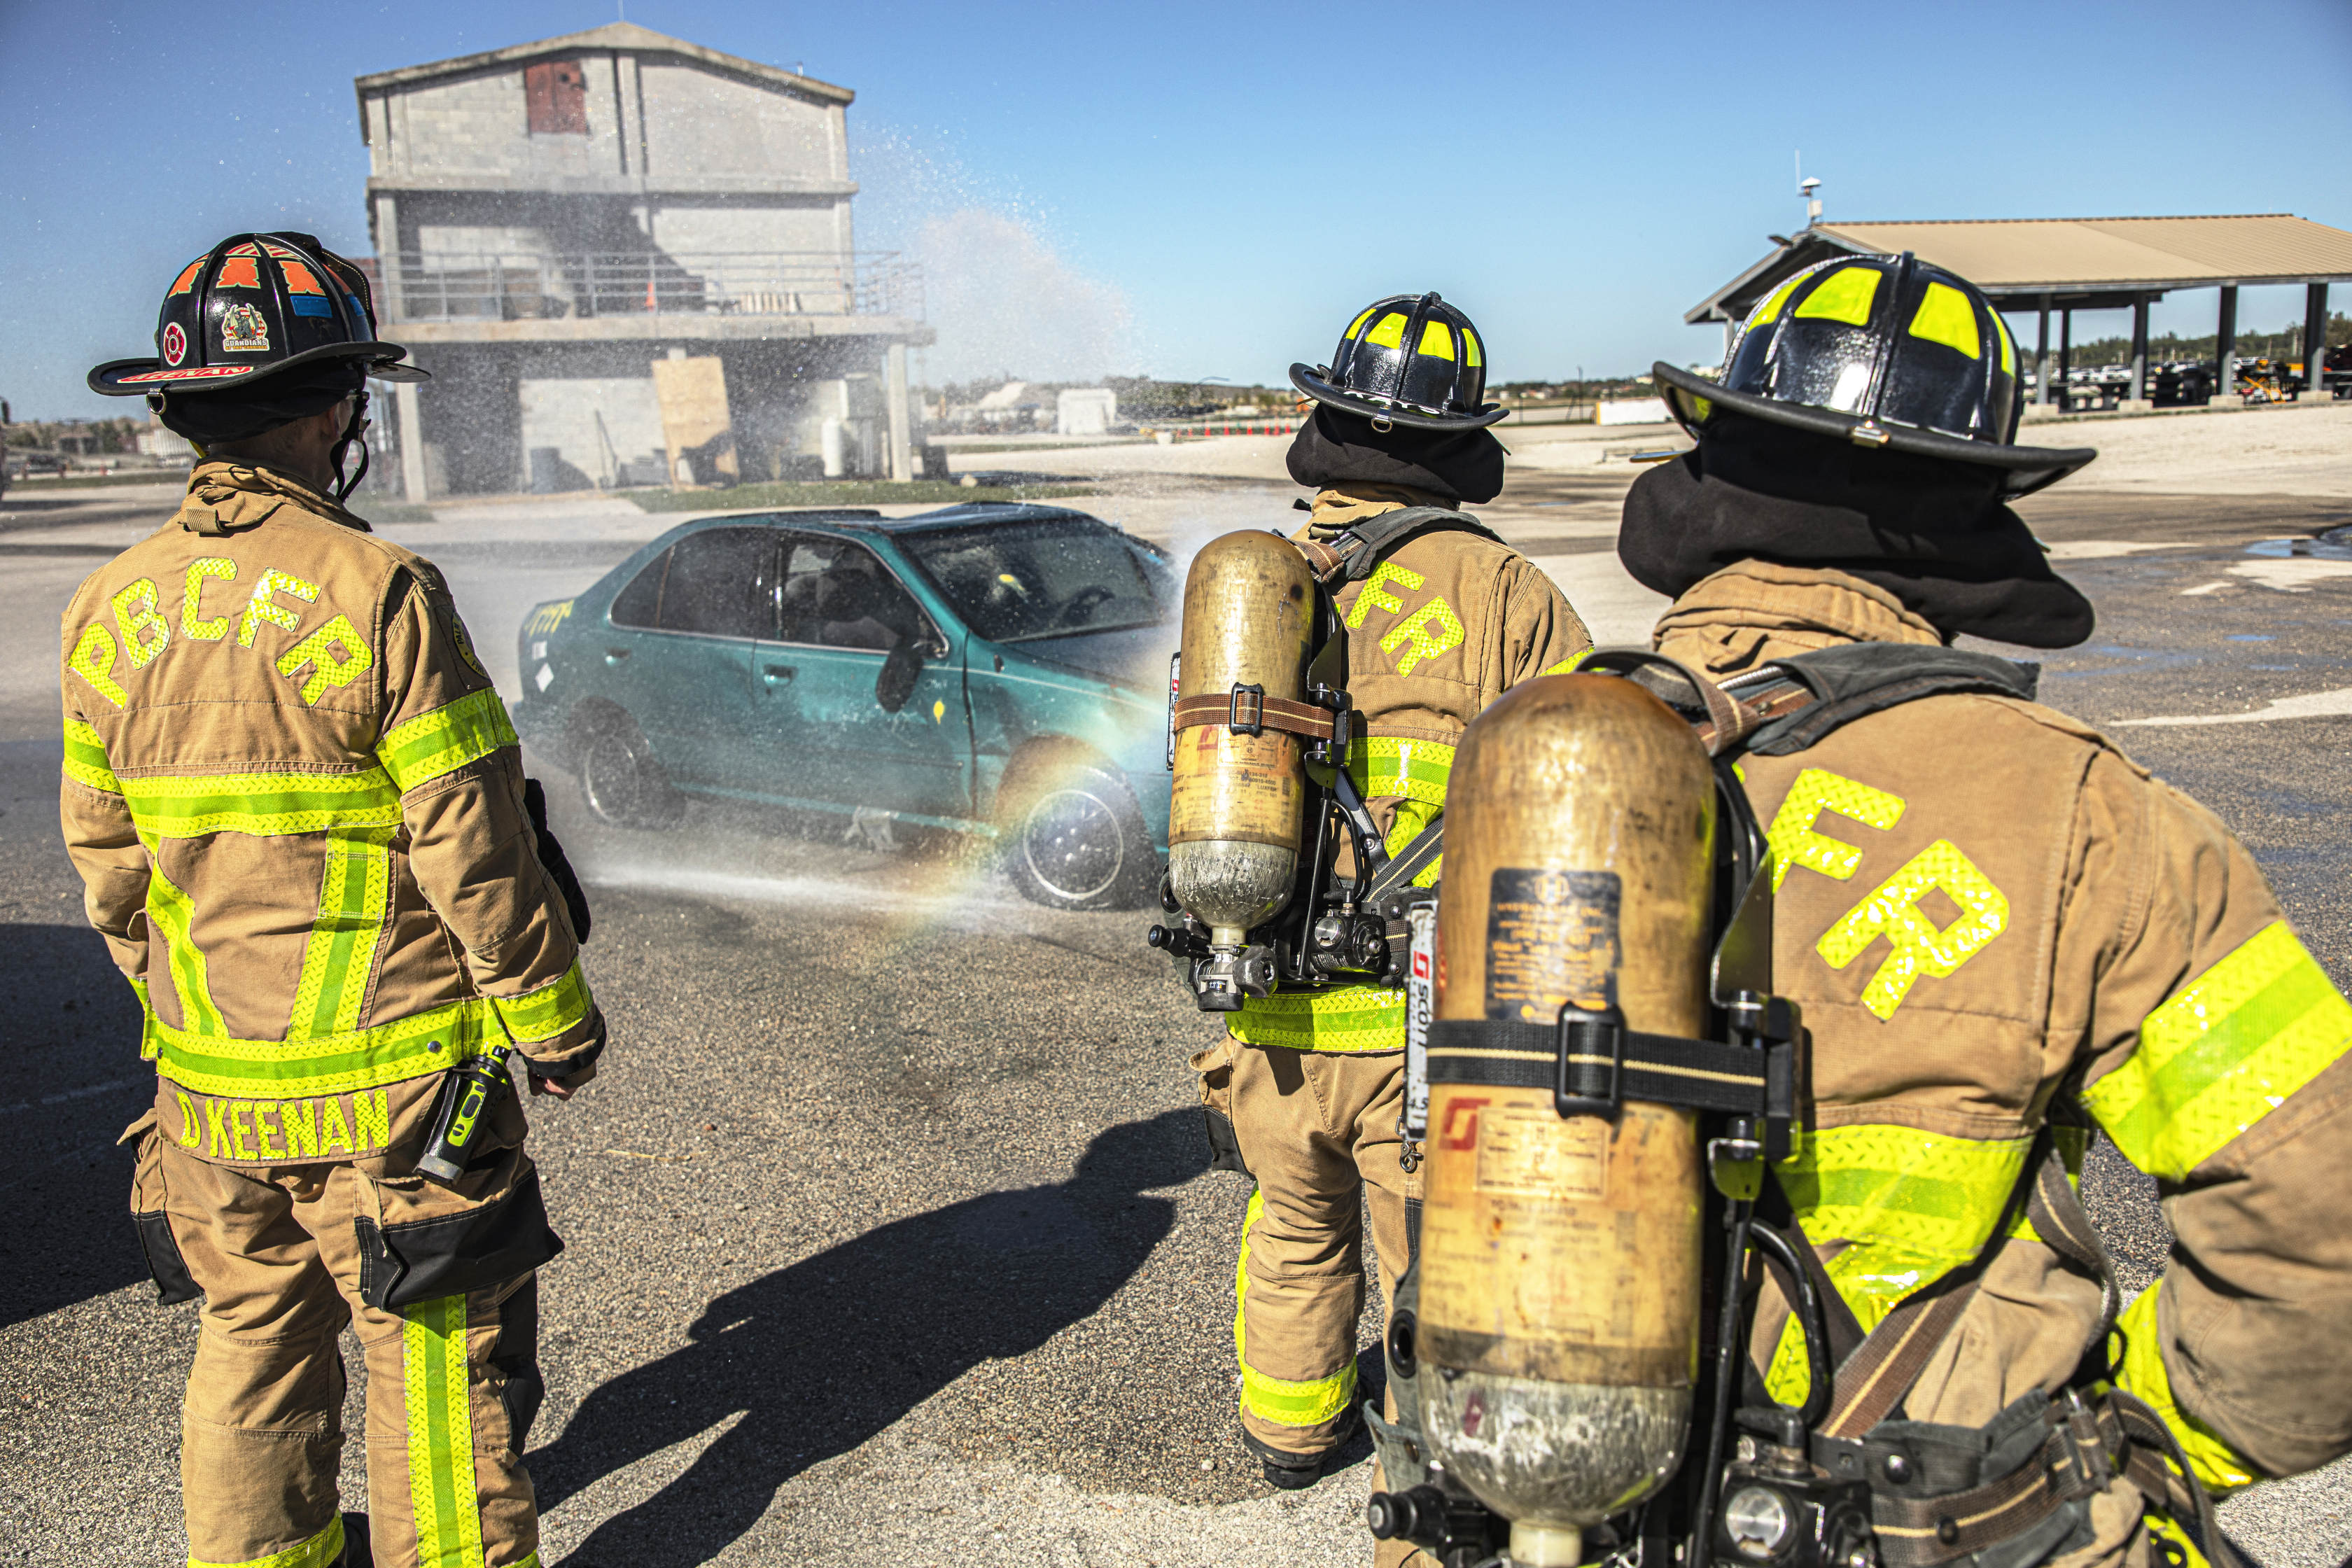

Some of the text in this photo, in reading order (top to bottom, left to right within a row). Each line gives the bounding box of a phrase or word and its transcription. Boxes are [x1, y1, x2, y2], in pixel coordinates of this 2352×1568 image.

[68, 556, 373, 710] PBCFR
[471, 659, 485, 676] FIRE
[1765, 768, 2010, 1021] FR
[204, 1088, 391, 1161] KEENAN
